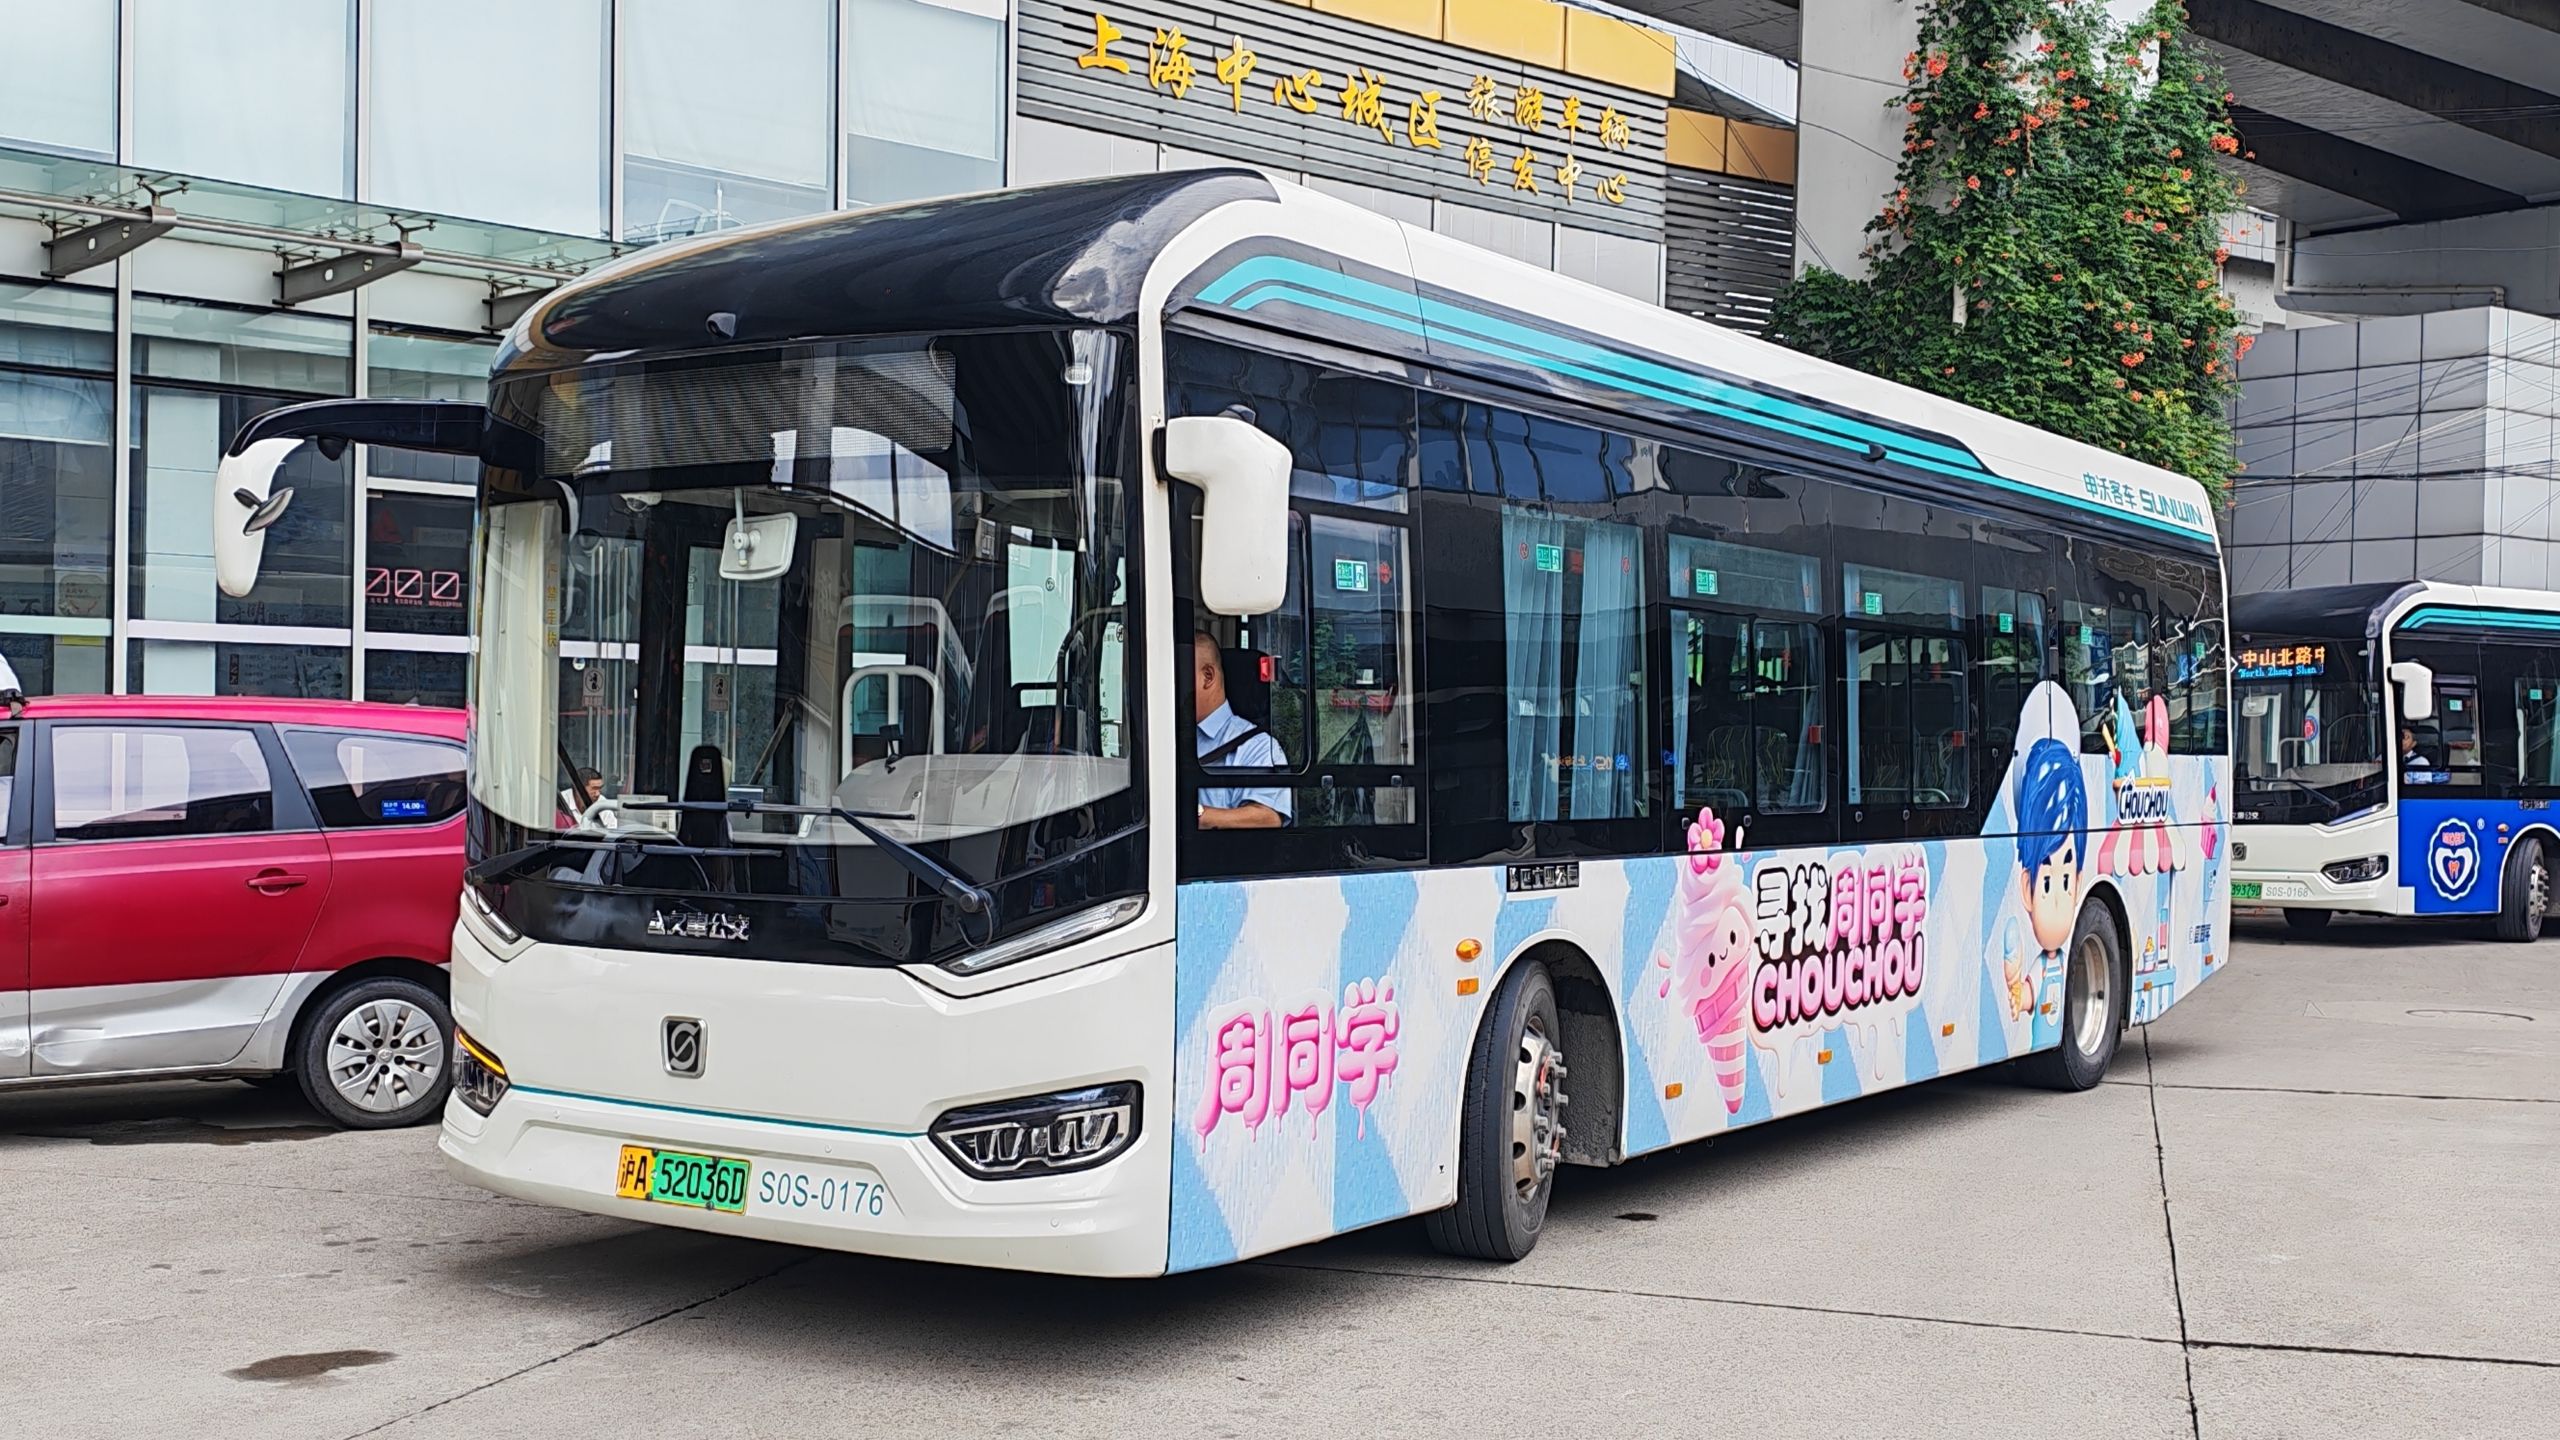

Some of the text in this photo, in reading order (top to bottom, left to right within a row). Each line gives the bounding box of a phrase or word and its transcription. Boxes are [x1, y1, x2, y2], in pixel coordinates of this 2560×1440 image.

[1078, 13, 1442, 149] 上海中心城区
[1466, 74, 1631, 151] 旅游车辆
[1463, 136, 1627, 205] 停发中心
[2083, 472, 2204, 526] 申沃客车 SUNWIN
[2268, 667, 2293, 677] Zhong
[2296, 664, 2317, 675] Shan
[2119, 783, 2168, 819] CHOUCHOU
[1755, 850, 1927, 961] 寻找周同学
[1753, 933, 1925, 1031] CHOUCHOU
[1195, 975, 1400, 1150] 周同学
